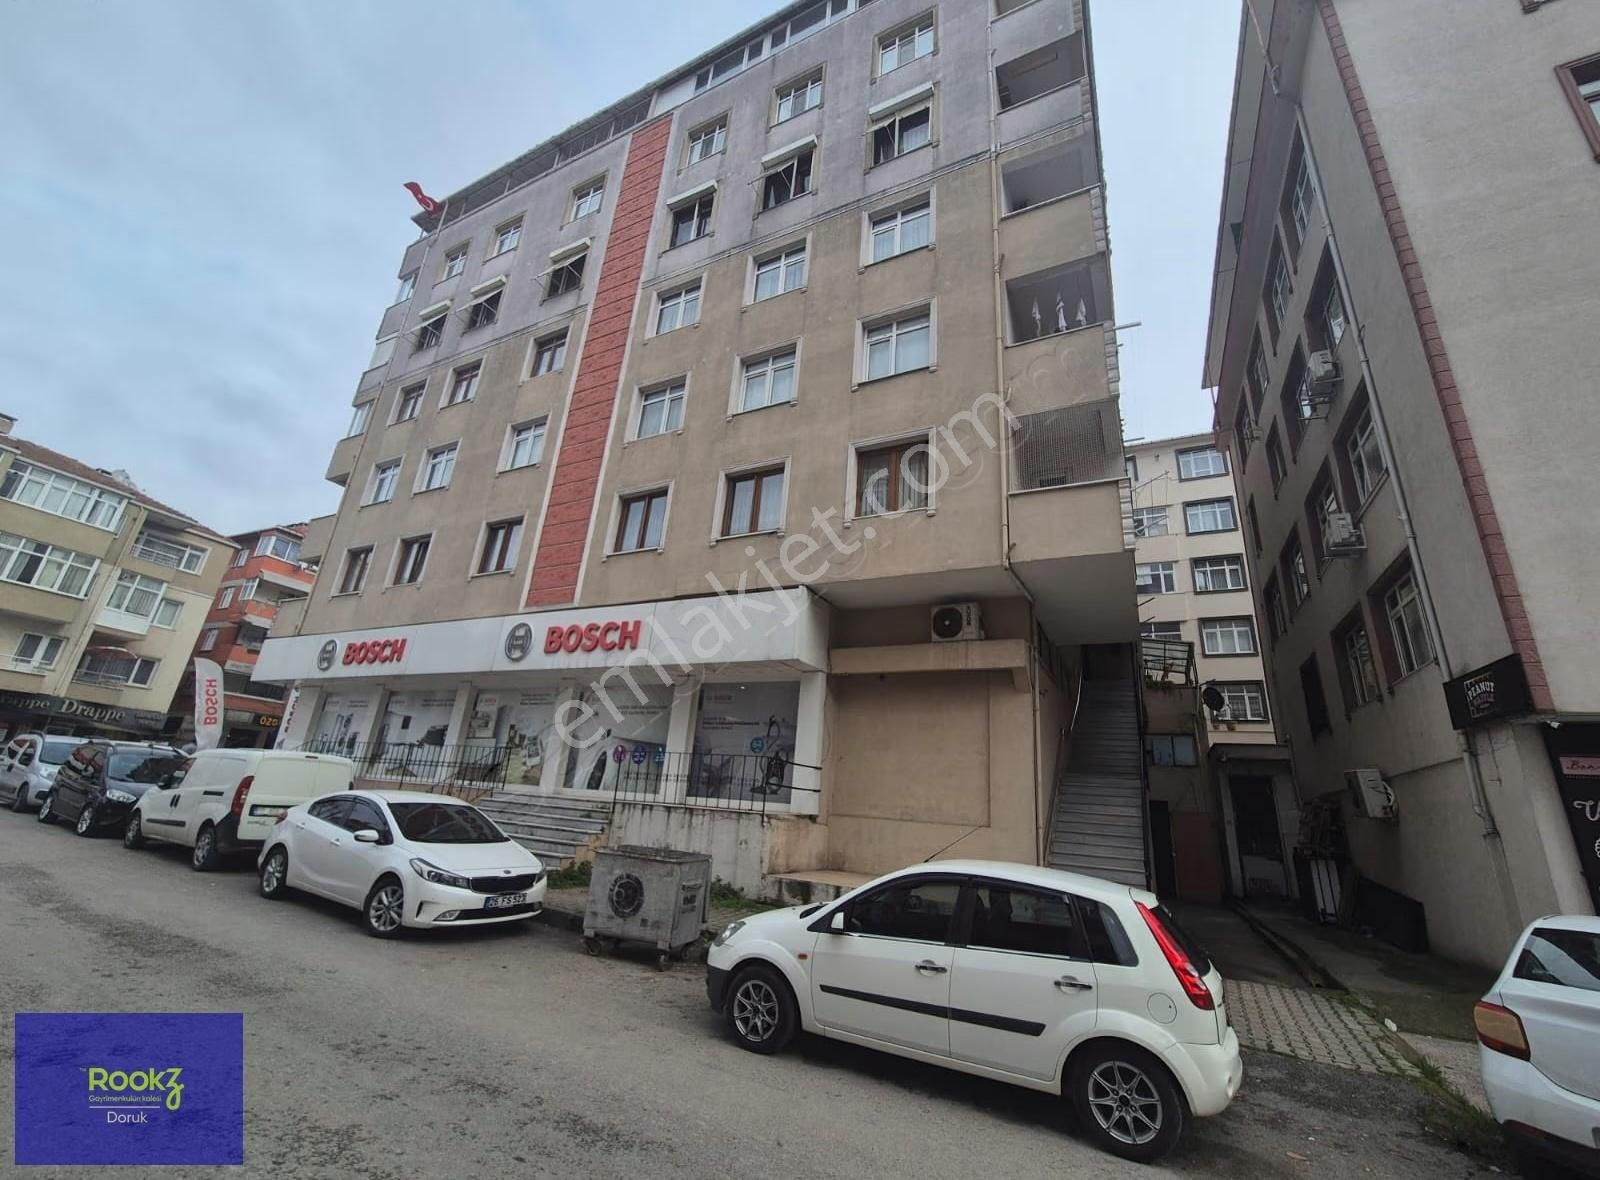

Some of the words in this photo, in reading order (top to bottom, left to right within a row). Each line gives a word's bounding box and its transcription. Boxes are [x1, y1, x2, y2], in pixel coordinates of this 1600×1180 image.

[544, 620, 642, 654] BOSCH
[342, 638, 407, 665] BOSCH
[60, 700, 126, 725] Drappe
